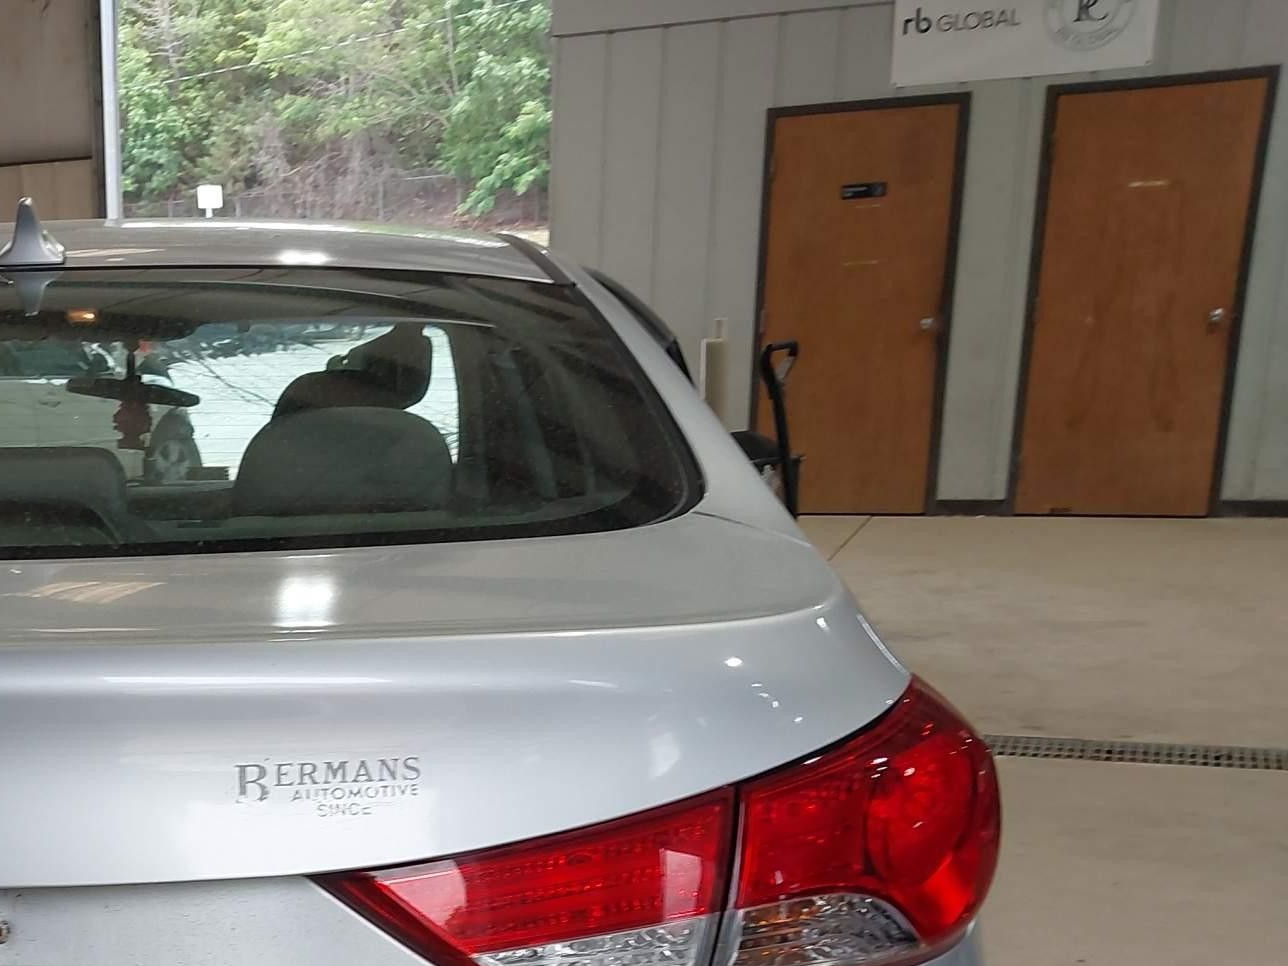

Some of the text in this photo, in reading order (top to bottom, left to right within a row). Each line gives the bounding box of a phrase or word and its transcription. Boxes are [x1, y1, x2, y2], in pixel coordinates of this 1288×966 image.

[902, 7, 1021, 36] rb GLOBAL
[233, 757, 421, 803] BERMANS
[291, 784, 420, 802] AUTOMOTIVE
